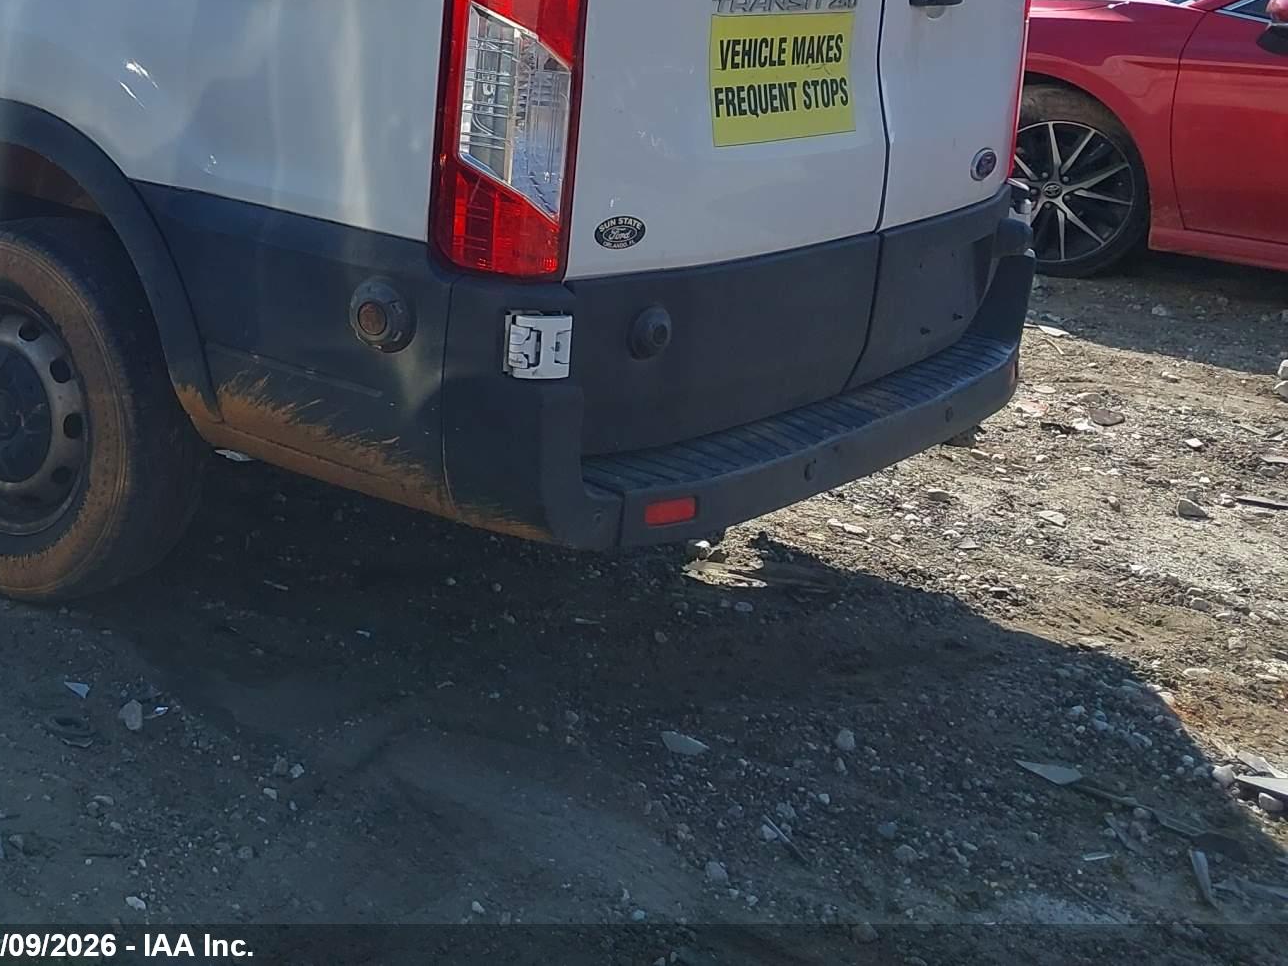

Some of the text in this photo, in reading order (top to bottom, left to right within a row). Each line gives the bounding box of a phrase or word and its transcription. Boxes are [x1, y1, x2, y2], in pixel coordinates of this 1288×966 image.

[719, 33, 844, 71] VEHICLE MAKES
[714, 77, 849, 118] FREQUENT STOPS
[599, 217, 642, 233] SUN STATE
